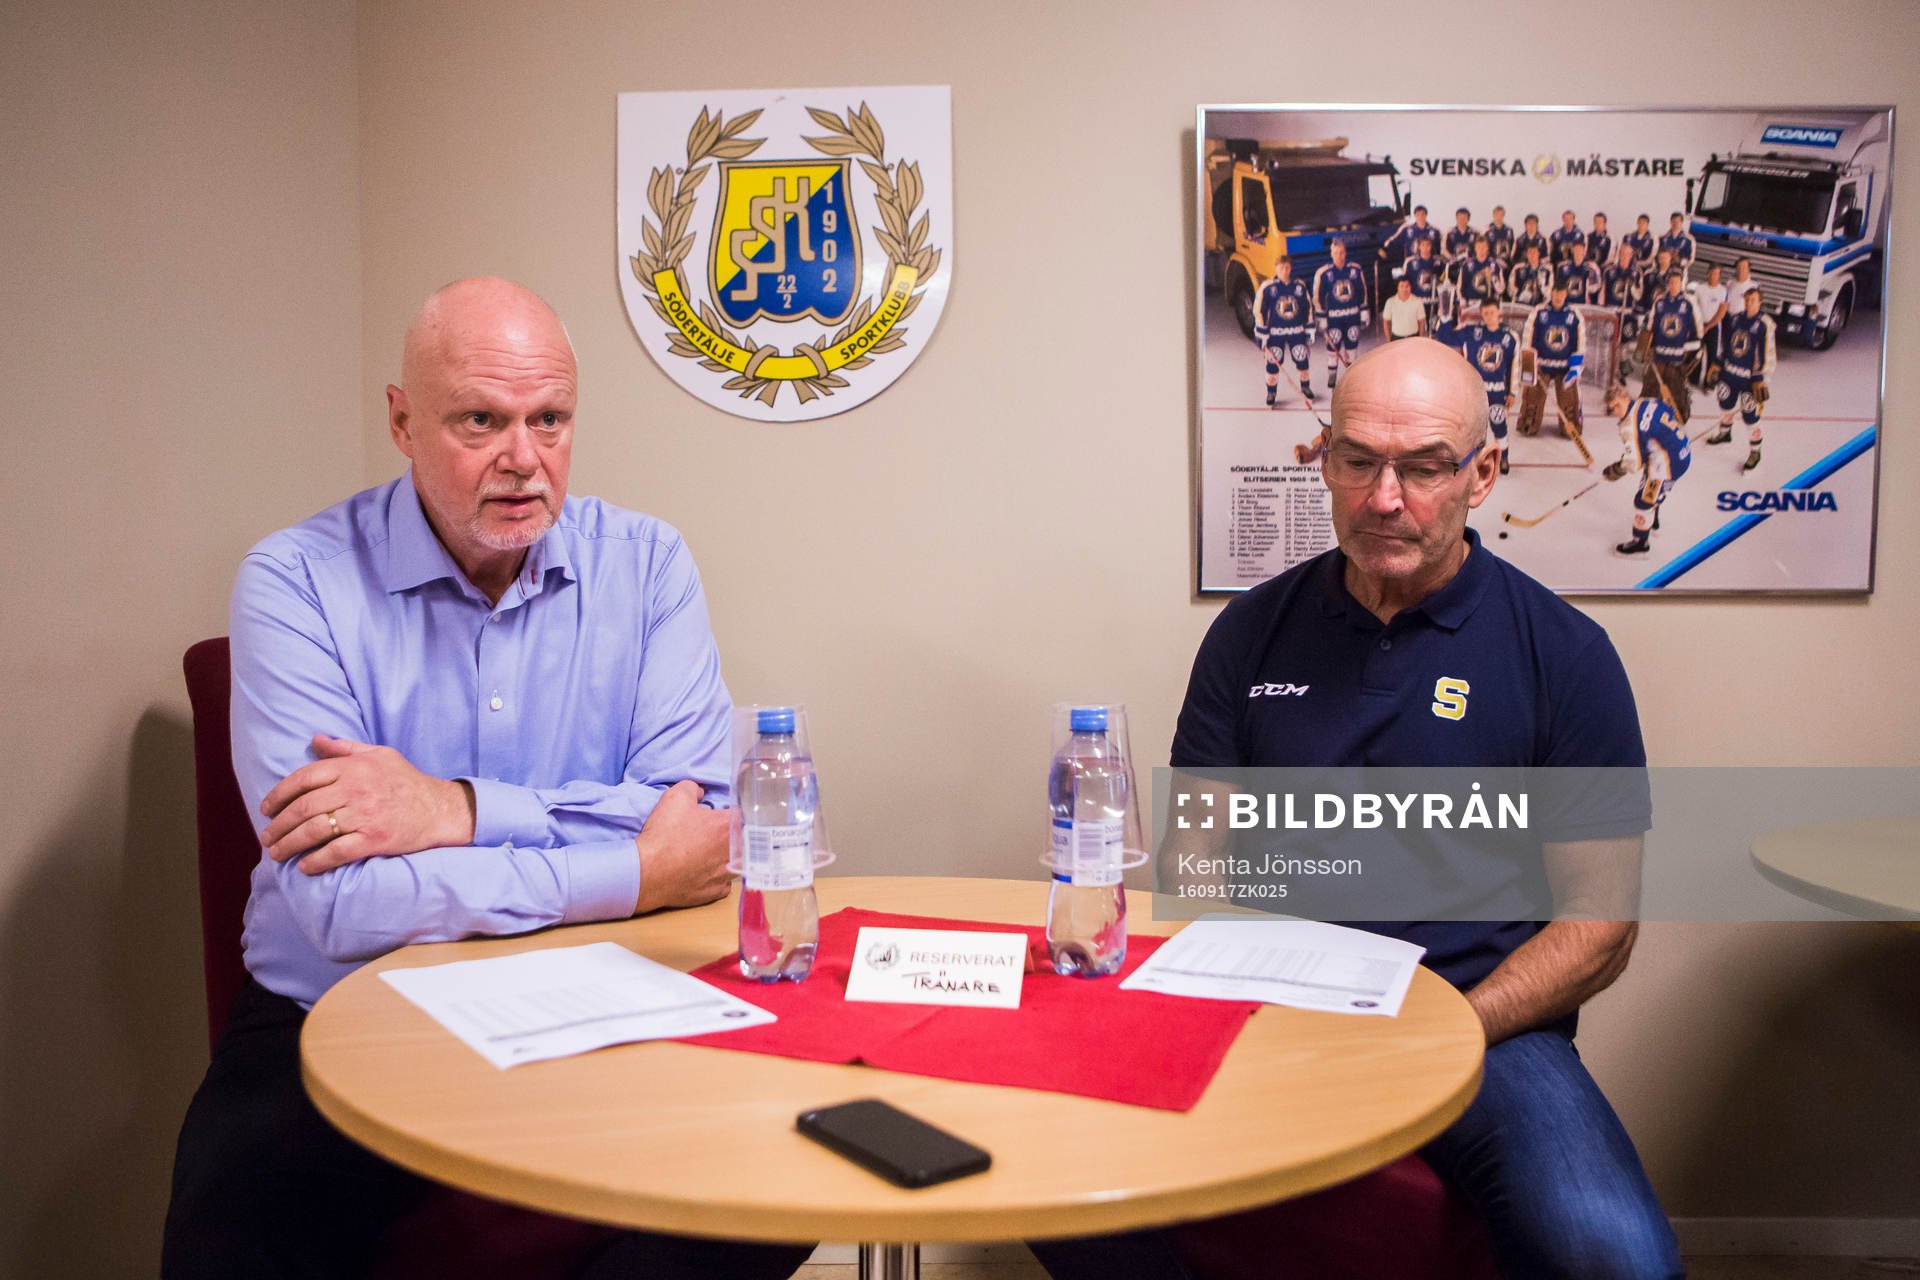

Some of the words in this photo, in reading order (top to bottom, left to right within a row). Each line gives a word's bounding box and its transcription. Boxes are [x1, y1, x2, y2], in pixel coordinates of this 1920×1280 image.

[1765, 128, 1837, 142] SCANIA
[1410, 158, 1526, 176] SVENSKA
[1566, 154, 1685, 176] MÄSTARE
[821, 180, 838, 293] 1902
[664, 292, 736, 364] SÖDERTÄLJE
[840, 280, 910, 360] SPORTKLUBB
[1716, 491, 1838, 512] SCANIA
[1249, 683, 1310, 697] CCM
[1432, 676, 1470, 721] S
[909, 950, 1016, 967] RESERVERAT
[902, 970, 1001, 993] TRÄNARE
